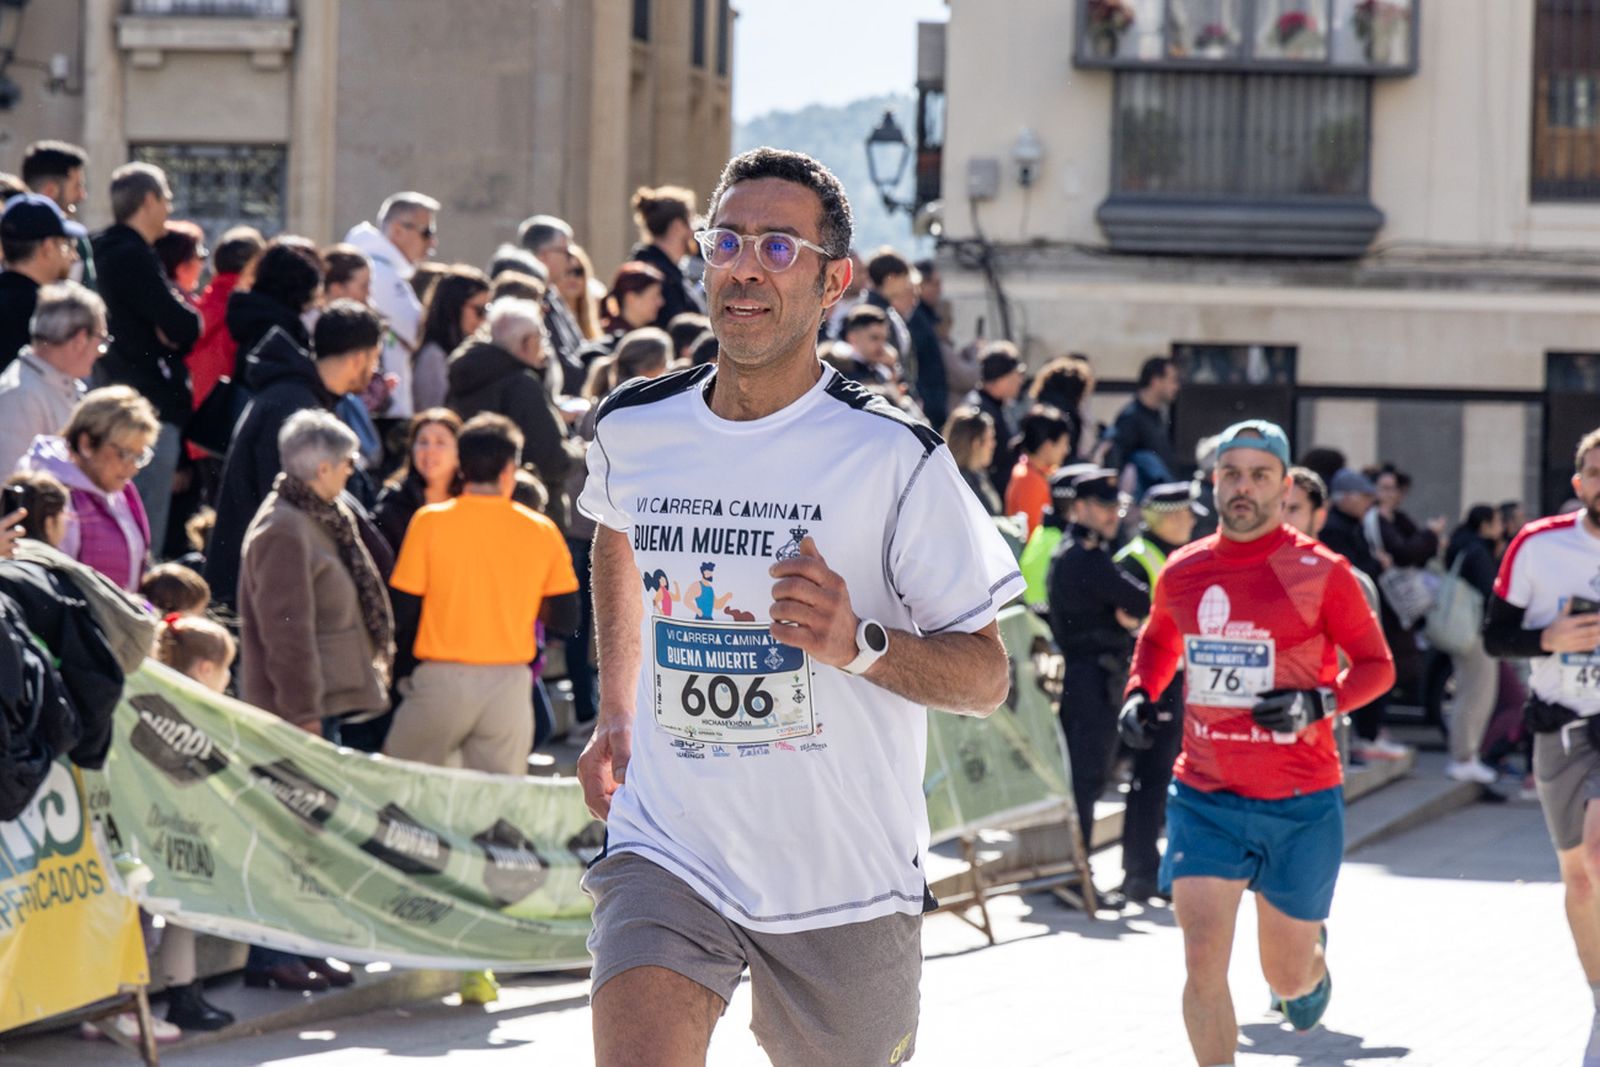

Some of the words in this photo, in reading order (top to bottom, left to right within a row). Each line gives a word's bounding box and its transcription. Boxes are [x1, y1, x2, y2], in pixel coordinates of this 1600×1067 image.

[636, 497, 648, 512] VI
[650, 497, 723, 516] CARRERA
[729, 500, 822, 521] CAMINATA
[634, 524, 684, 552] BUENA
[691, 527, 774, 557] MUERTE
[666, 630, 675, 640] VI
[676, 630, 722, 644] CARRERA
[667, 646, 702, 668] BUENA
[706, 650, 758, 670] MUERTE
[1210, 668, 1240, 691] 76
[681, 674, 774, 719] 606
